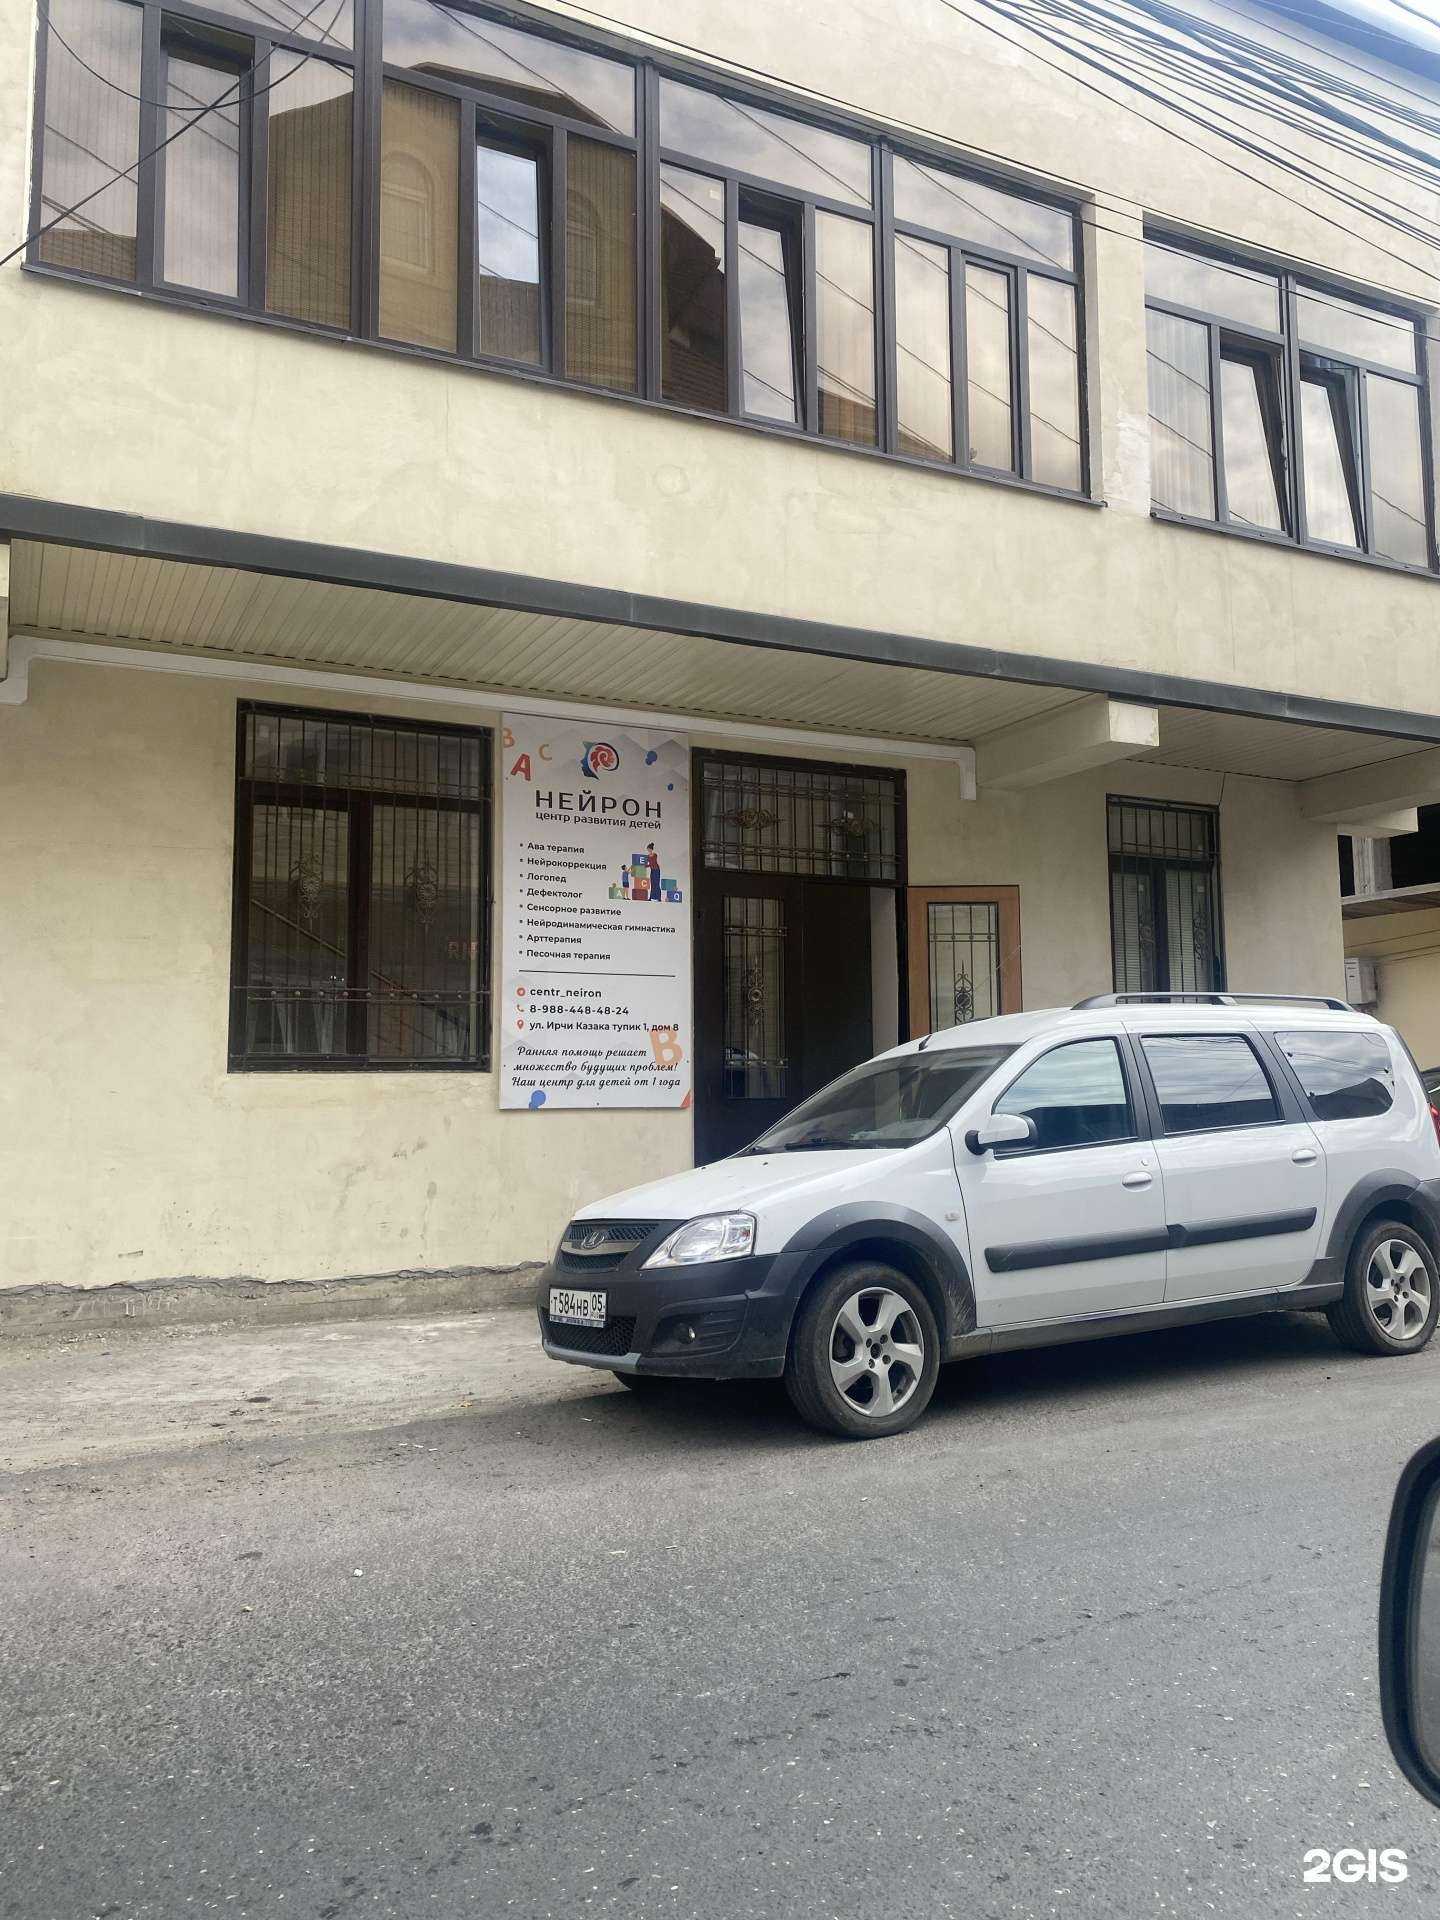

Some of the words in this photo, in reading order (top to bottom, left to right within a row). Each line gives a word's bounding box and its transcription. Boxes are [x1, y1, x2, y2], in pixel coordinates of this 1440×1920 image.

[535, 789, 662, 819] НЕЙРОН
[535, 811, 571, 824] центр
[574, 815, 626, 829] развития
[629, 819, 662, 830] детей
[527, 842, 545, 852] Ава
[546, 844, 585, 855] терапия
[527, 857, 607, 871] Нейрокоррекция
[526, 872, 567, 884] Логопед
[526, 887, 584, 900] Дефектолог
[526, 903, 577, 914] Сенсорное
[579, 906, 622, 917] развитие
[526, 918, 623, 932] Нейродинамическая
[624, 924, 676, 934] гимнастика
[526, 934, 582, 945] Арттерапия
[526, 949, 571, 960] Песочная
[573, 952, 611, 962] терапия
[529, 987, 602, 999] centr_neiron
[529, 1004, 629, 1016] 8-988-448-48-24
[529, 1022, 544, 1031] ул.
[546, 1021, 574, 1032] Ирчи
[576, 1021, 610, 1032] Казака
[612, 1024, 641, 1034] тупик
[651, 1024, 671, 1033] дом
[672, 1023, 680, 1032] 8
[516, 1046, 558, 1057] Ранняя
[561, 1049, 603, 1058] помощь
[604, 1048, 648, 1059] решает
[513, 1060, 577, 1072] множество
[580, 1060, 627, 1075] будущих
[629, 1061, 678, 1075] проблем!
[511, 1076, 538, 1087] Наш
[539, 1079, 574, 1090] центр
[576, 1078, 596, 1089] для
[598, 1076, 632, 1089] детей
[634, 1079, 649, 1087] от
[658, 1079, 681, 1090] года
